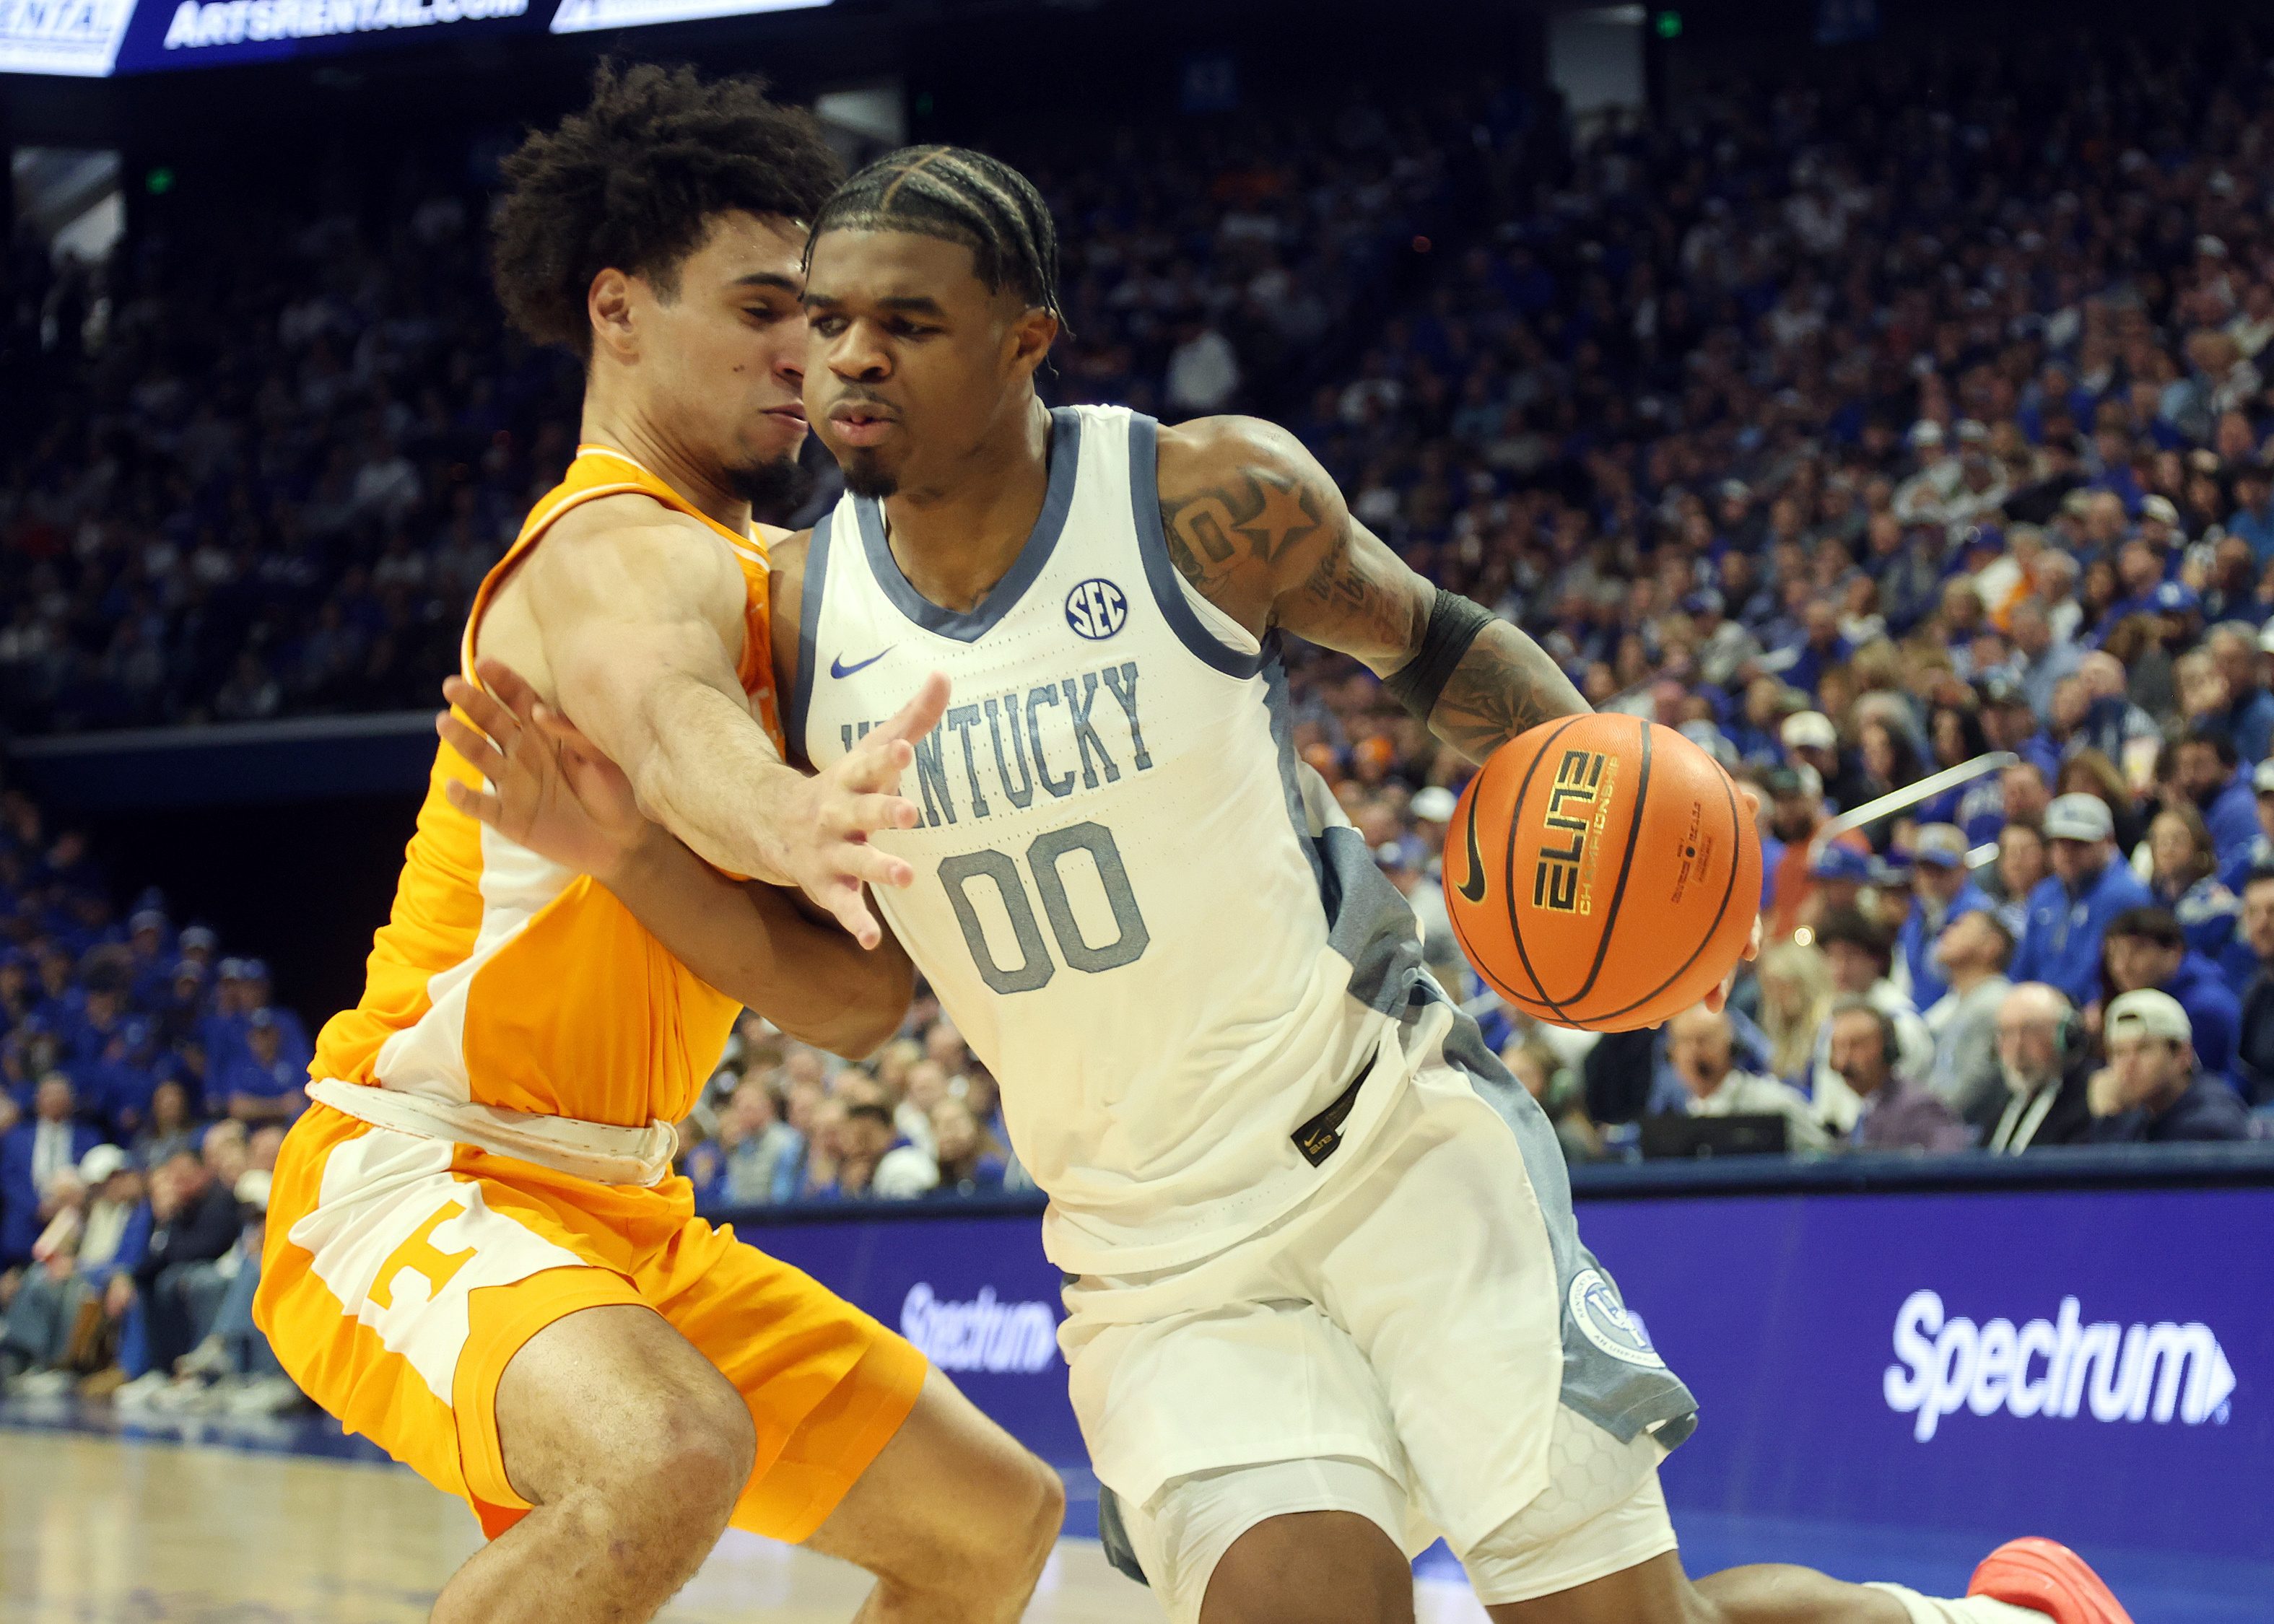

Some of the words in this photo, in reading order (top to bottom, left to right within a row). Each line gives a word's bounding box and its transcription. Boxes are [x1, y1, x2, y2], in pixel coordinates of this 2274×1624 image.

[1067, 580, 1126, 638] SEC
[841, 661, 1154, 829] NTUCKY
[937, 821, 1151, 995] 00
[1533, 748, 1608, 914] ELITE
[1580, 754, 1619, 916] CHAMPIONSHIP
[900, 1281, 1058, 1374] Spectrum
[1883, 1288, 2223, 1444] Spectrum
